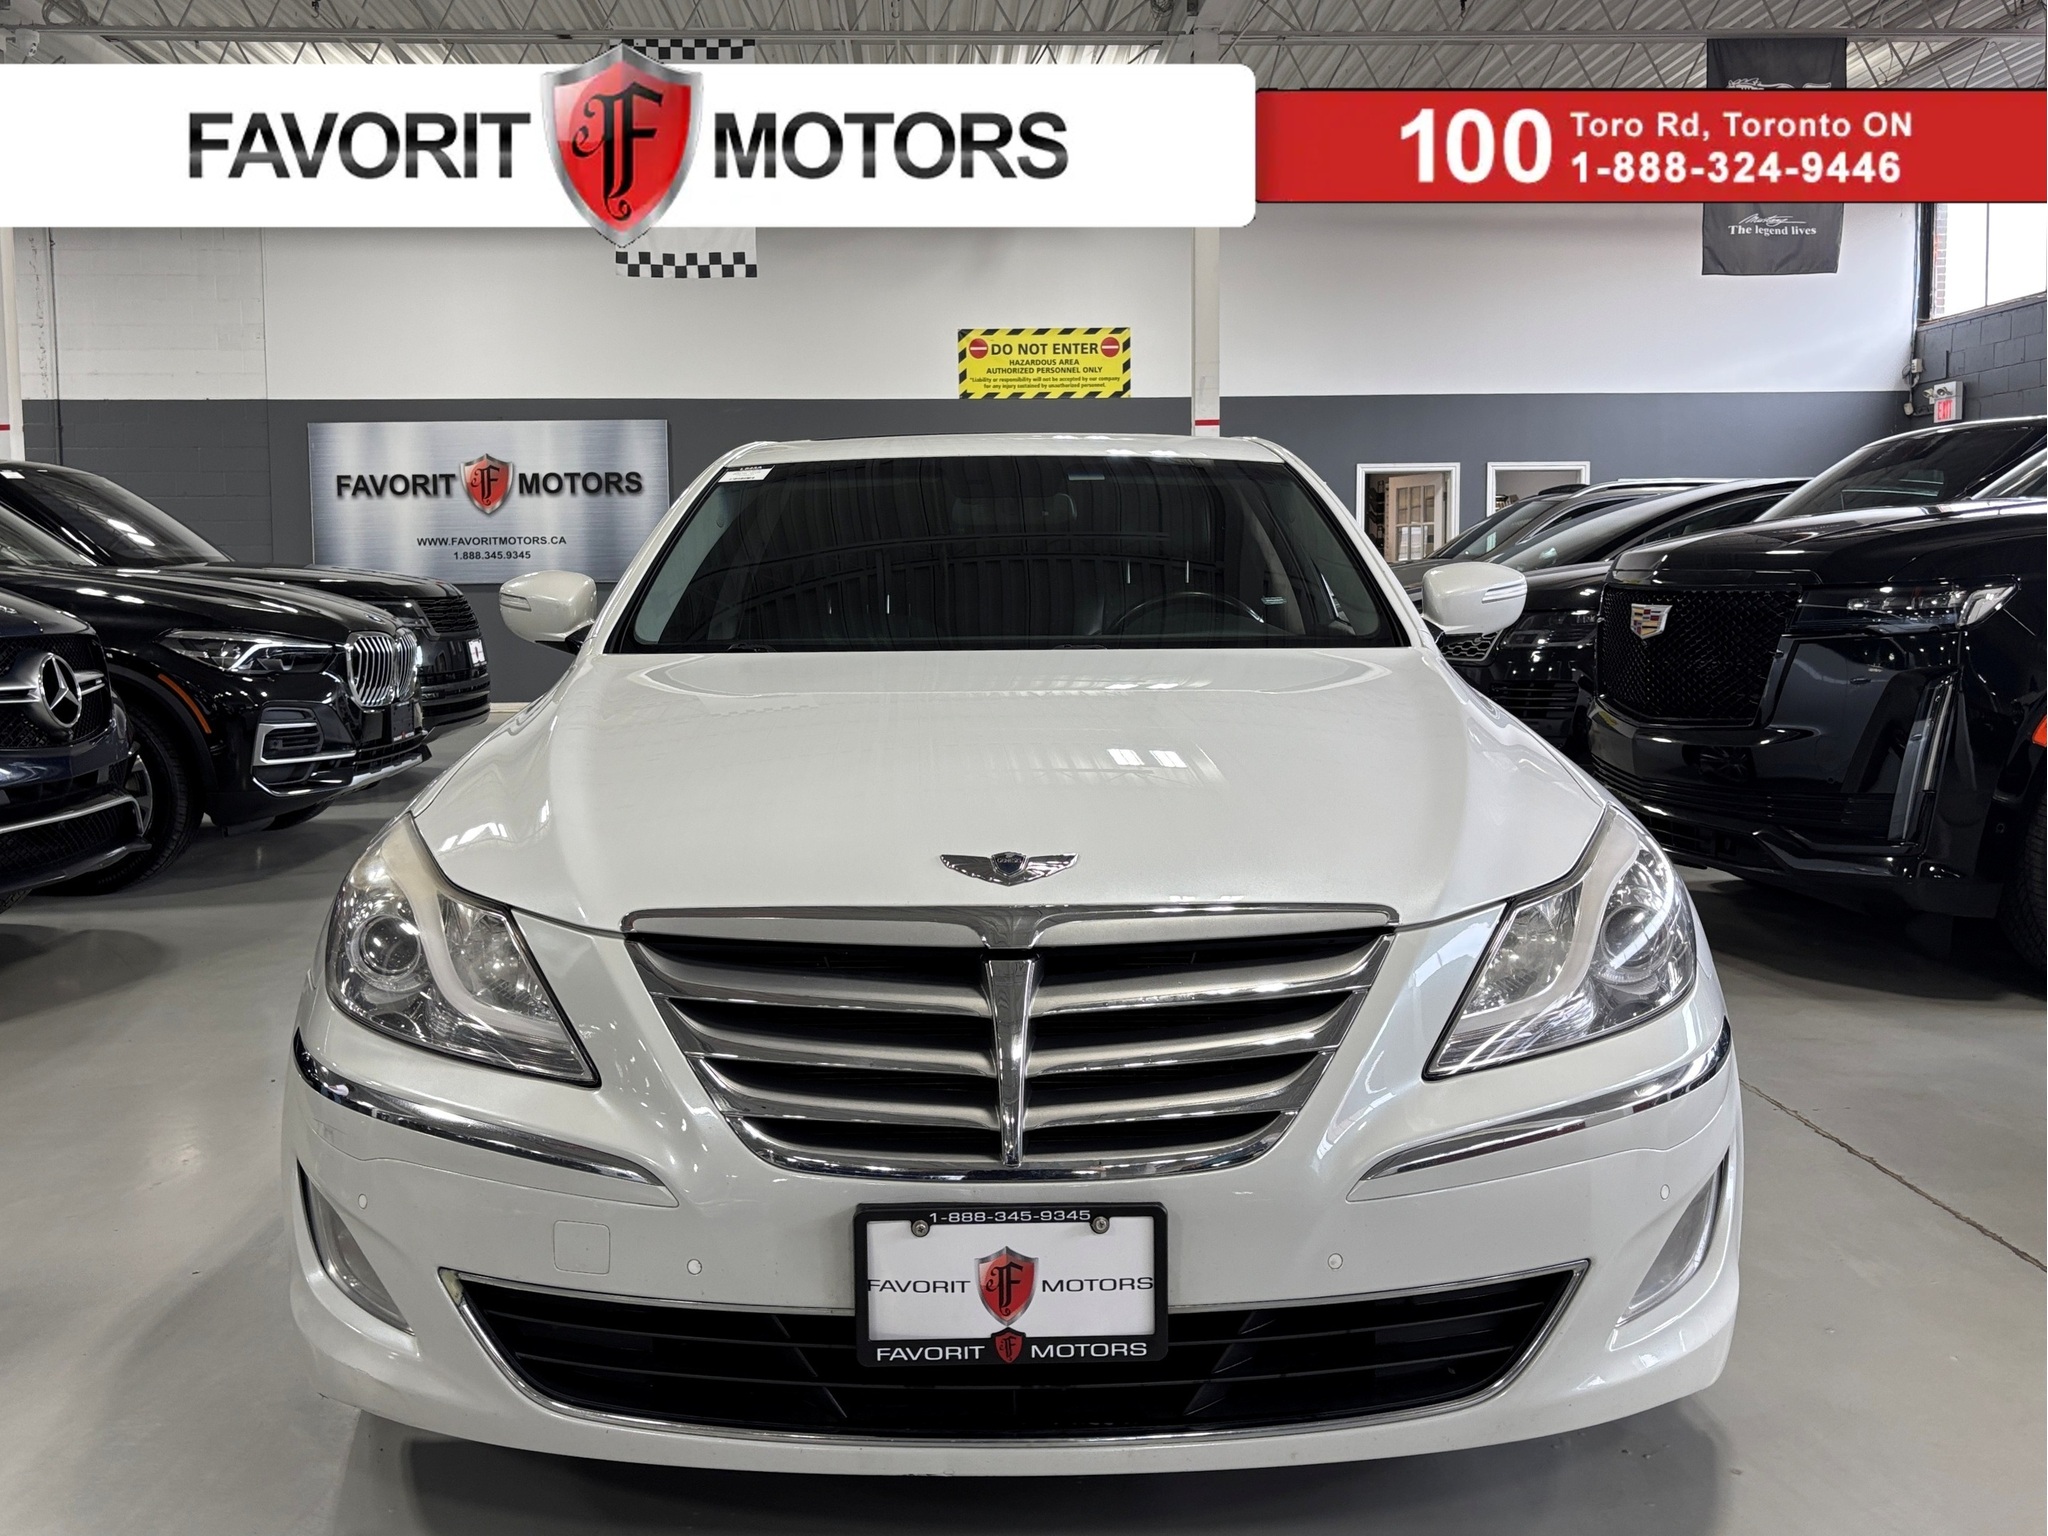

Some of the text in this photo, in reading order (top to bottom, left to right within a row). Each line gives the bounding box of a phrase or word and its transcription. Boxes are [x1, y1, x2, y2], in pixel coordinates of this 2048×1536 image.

[1728, 225, 1817, 237] The legend lives
[991, 342, 1099, 355] DO NOT ENTER
[1059, 358, 1080, 366] AREA
[986, 367, 1035, 375] AUTHORIZED
[1036, 366, 1081, 374] PERSONNEL
[336, 473, 456, 497] FAVORIT
[518, 471, 643, 495] MOTORS
[417, 536, 567, 546] WWW.FAVORITMOTORS.CA
[453, 551, 531, 560] 1.888.345.9345
[929, 1210, 1091, 1223] 1-888-345-9345
[867, 1279, 971, 1293] FAVORIT
[1042, 1277, 1153, 1292] MOTORS
[876, 1346, 985, 1361] FAVORIT
[1031, 1342, 1147, 1358] MOTORS
